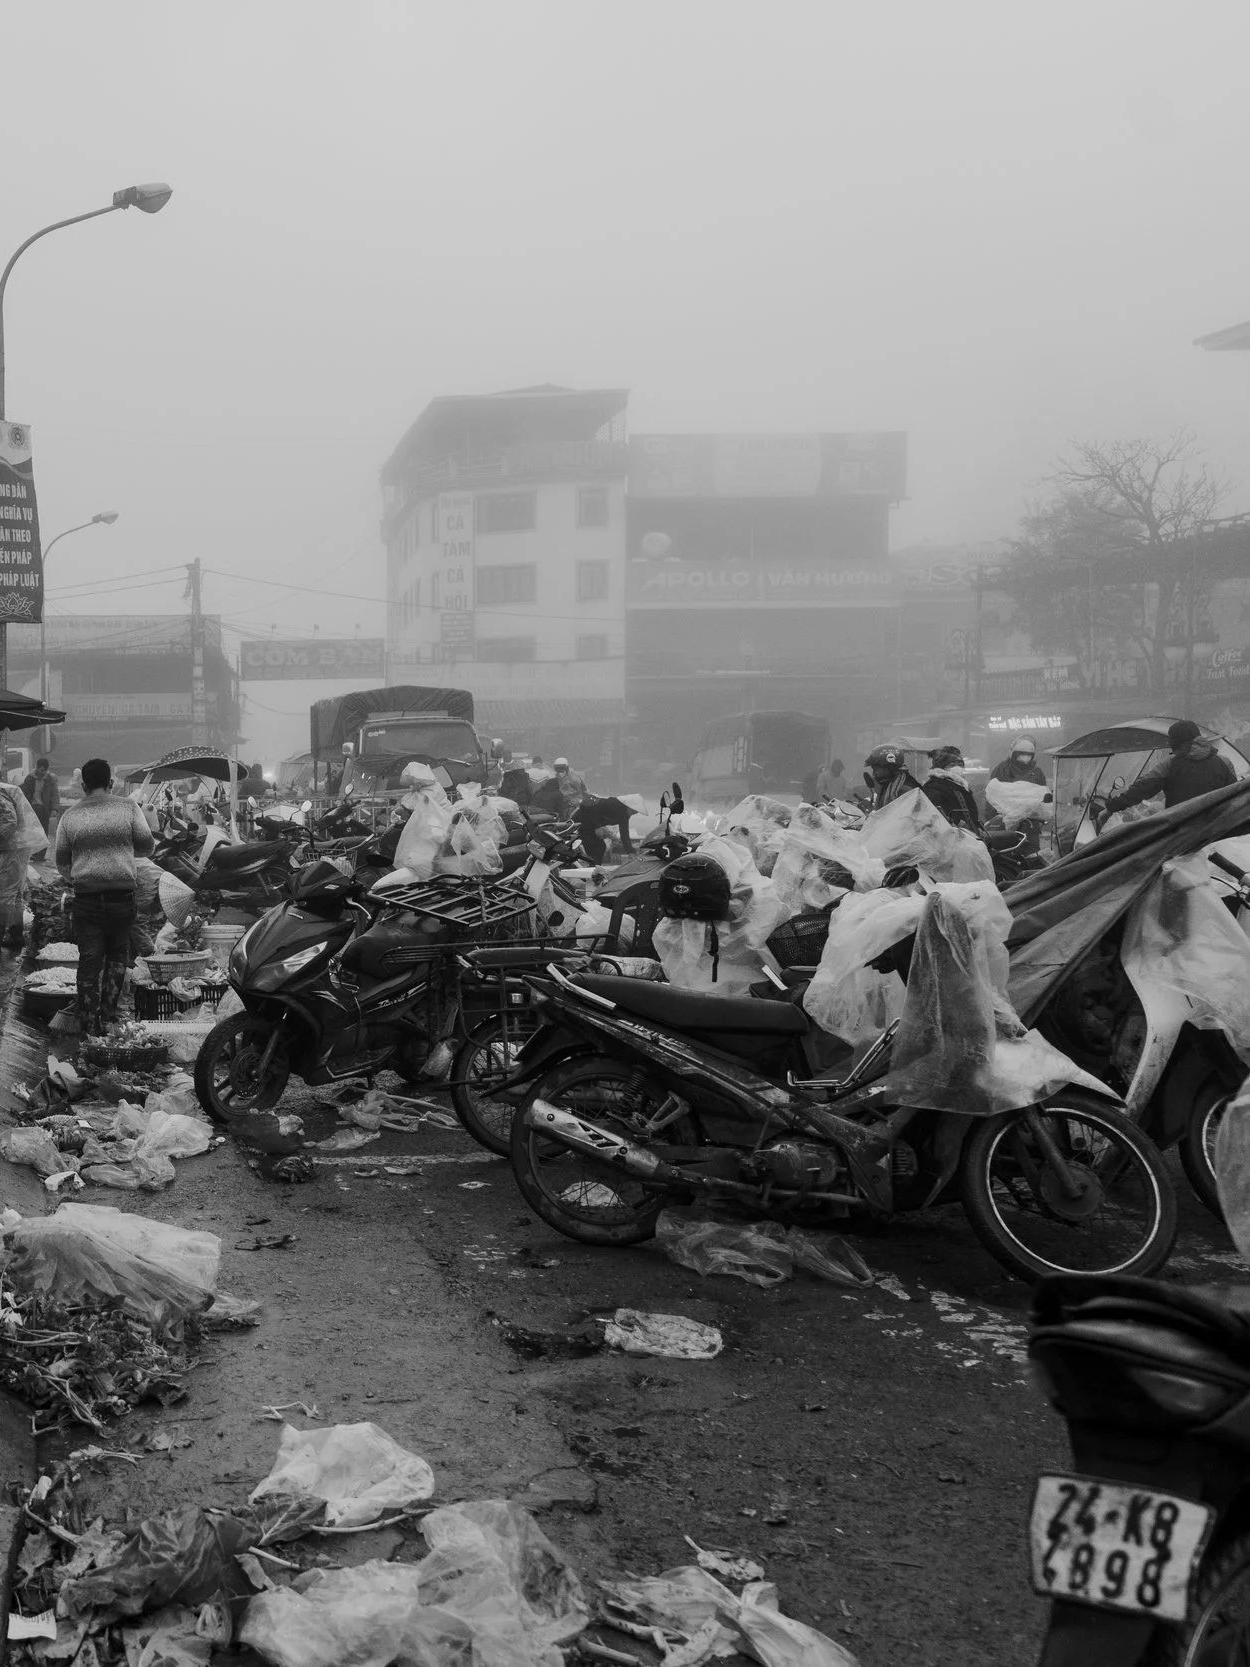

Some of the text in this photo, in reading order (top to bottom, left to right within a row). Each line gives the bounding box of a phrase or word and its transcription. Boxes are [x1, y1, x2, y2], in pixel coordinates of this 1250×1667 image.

[11, 482, 27, 499] DÂN
[22, 507, 33, 524] VỤ
[11, 529, 32, 543] THEO
[11, 548, 32, 565] PHÁP
[20, 571, 40, 590] LUẬT
[639, 570, 751, 592] APOLLO
